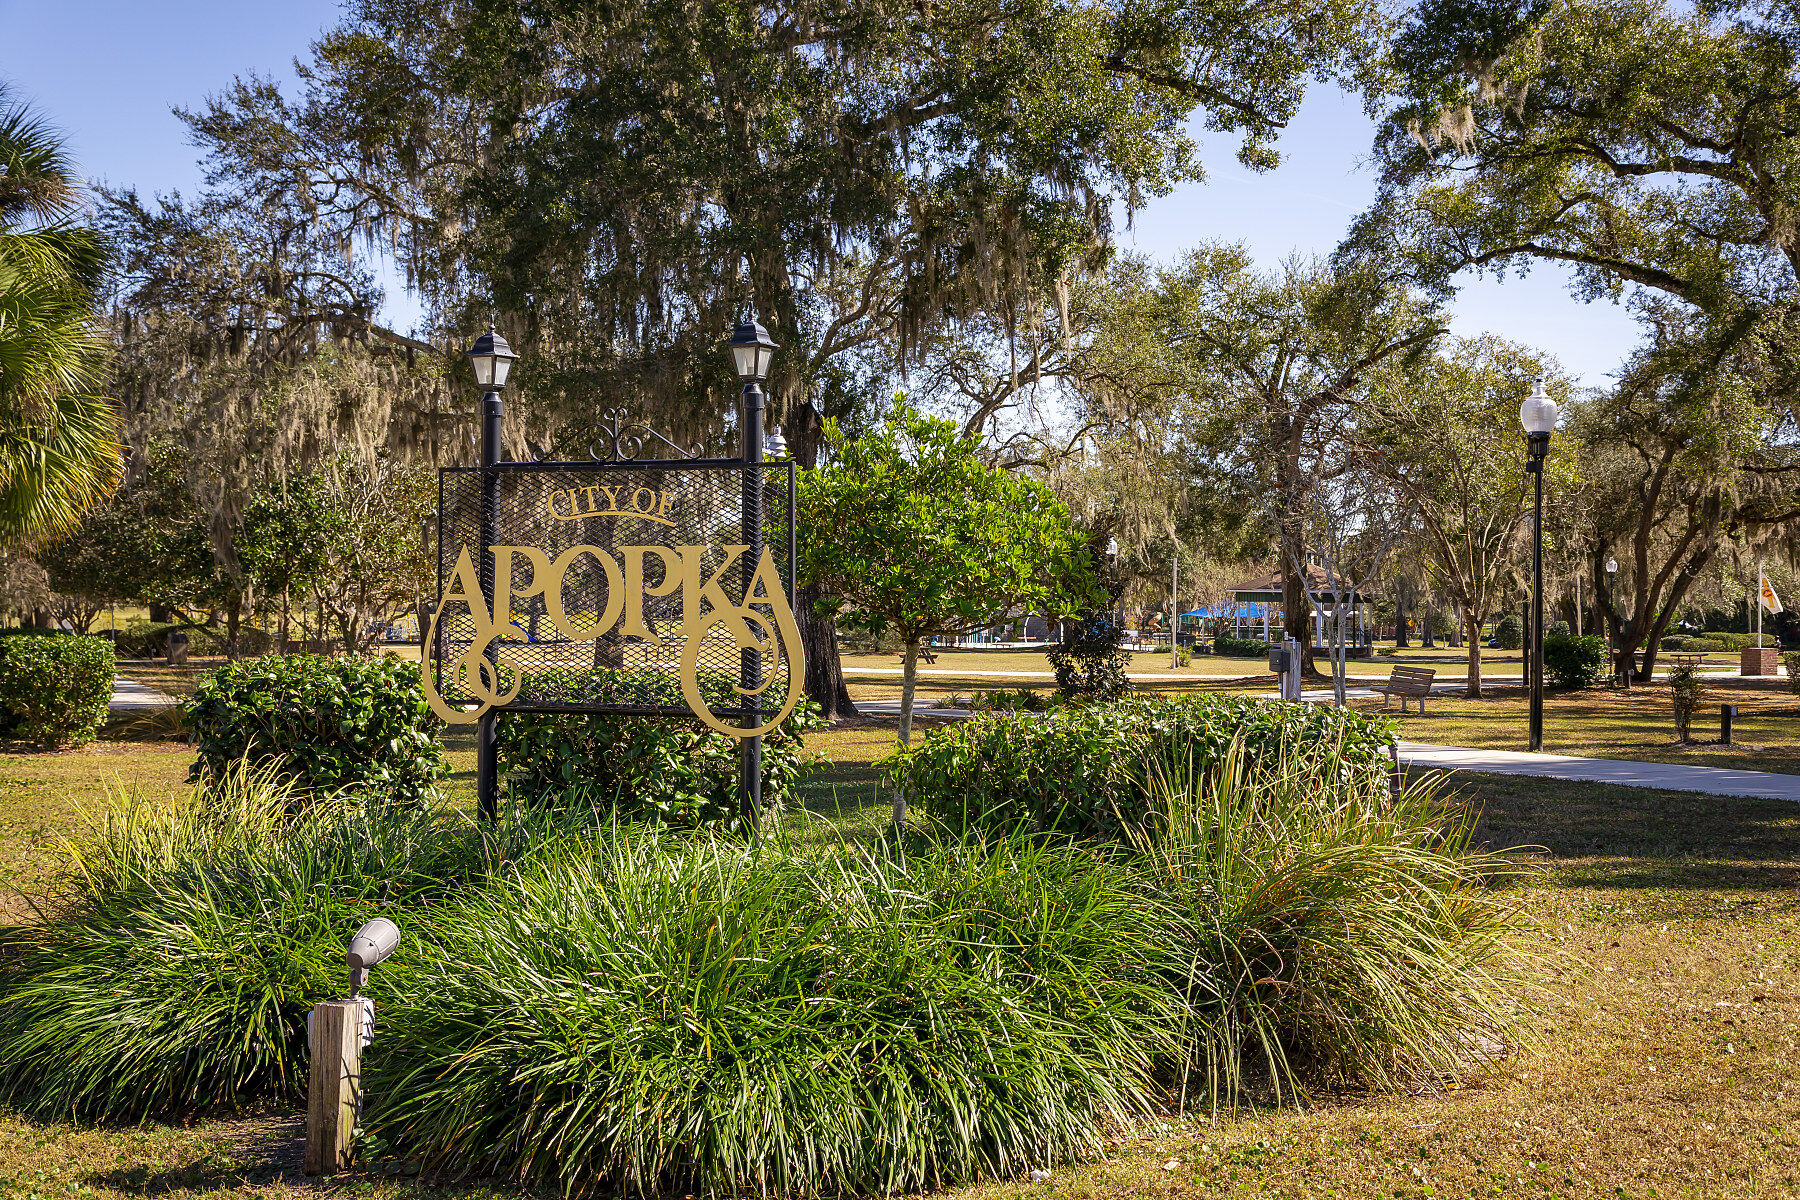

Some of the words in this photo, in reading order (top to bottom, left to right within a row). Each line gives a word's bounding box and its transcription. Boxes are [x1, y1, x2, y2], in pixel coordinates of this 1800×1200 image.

[547, 484, 623, 520] CITY
[632, 487, 676, 518] OF
[422, 543, 806, 738] APOPKA
